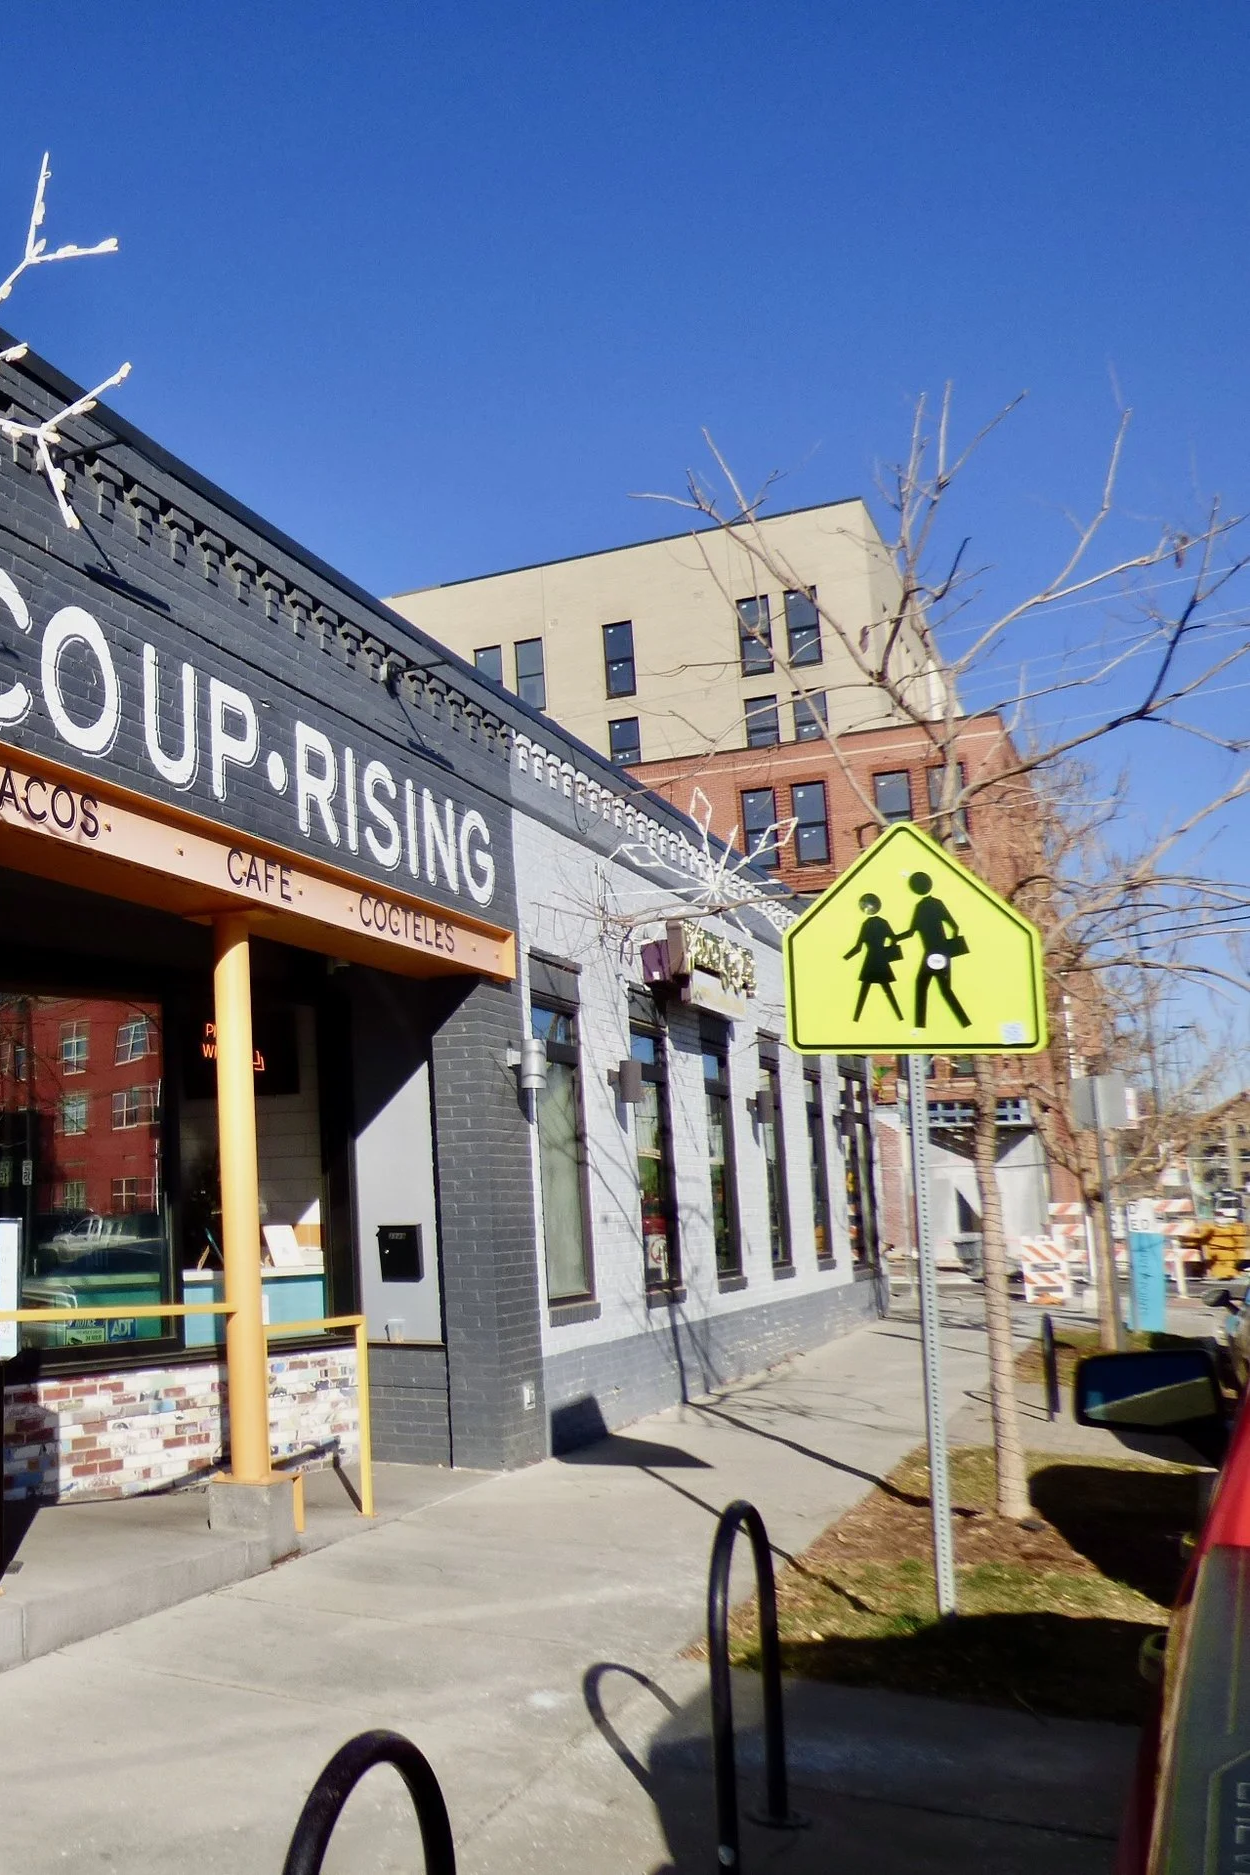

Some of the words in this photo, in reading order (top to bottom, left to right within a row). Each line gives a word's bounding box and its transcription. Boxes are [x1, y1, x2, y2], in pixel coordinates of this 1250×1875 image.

[225, 847, 295, 905] CAFE
[357, 892, 456, 955] COCTELES
[111, 1319, 134, 1338] ADT
